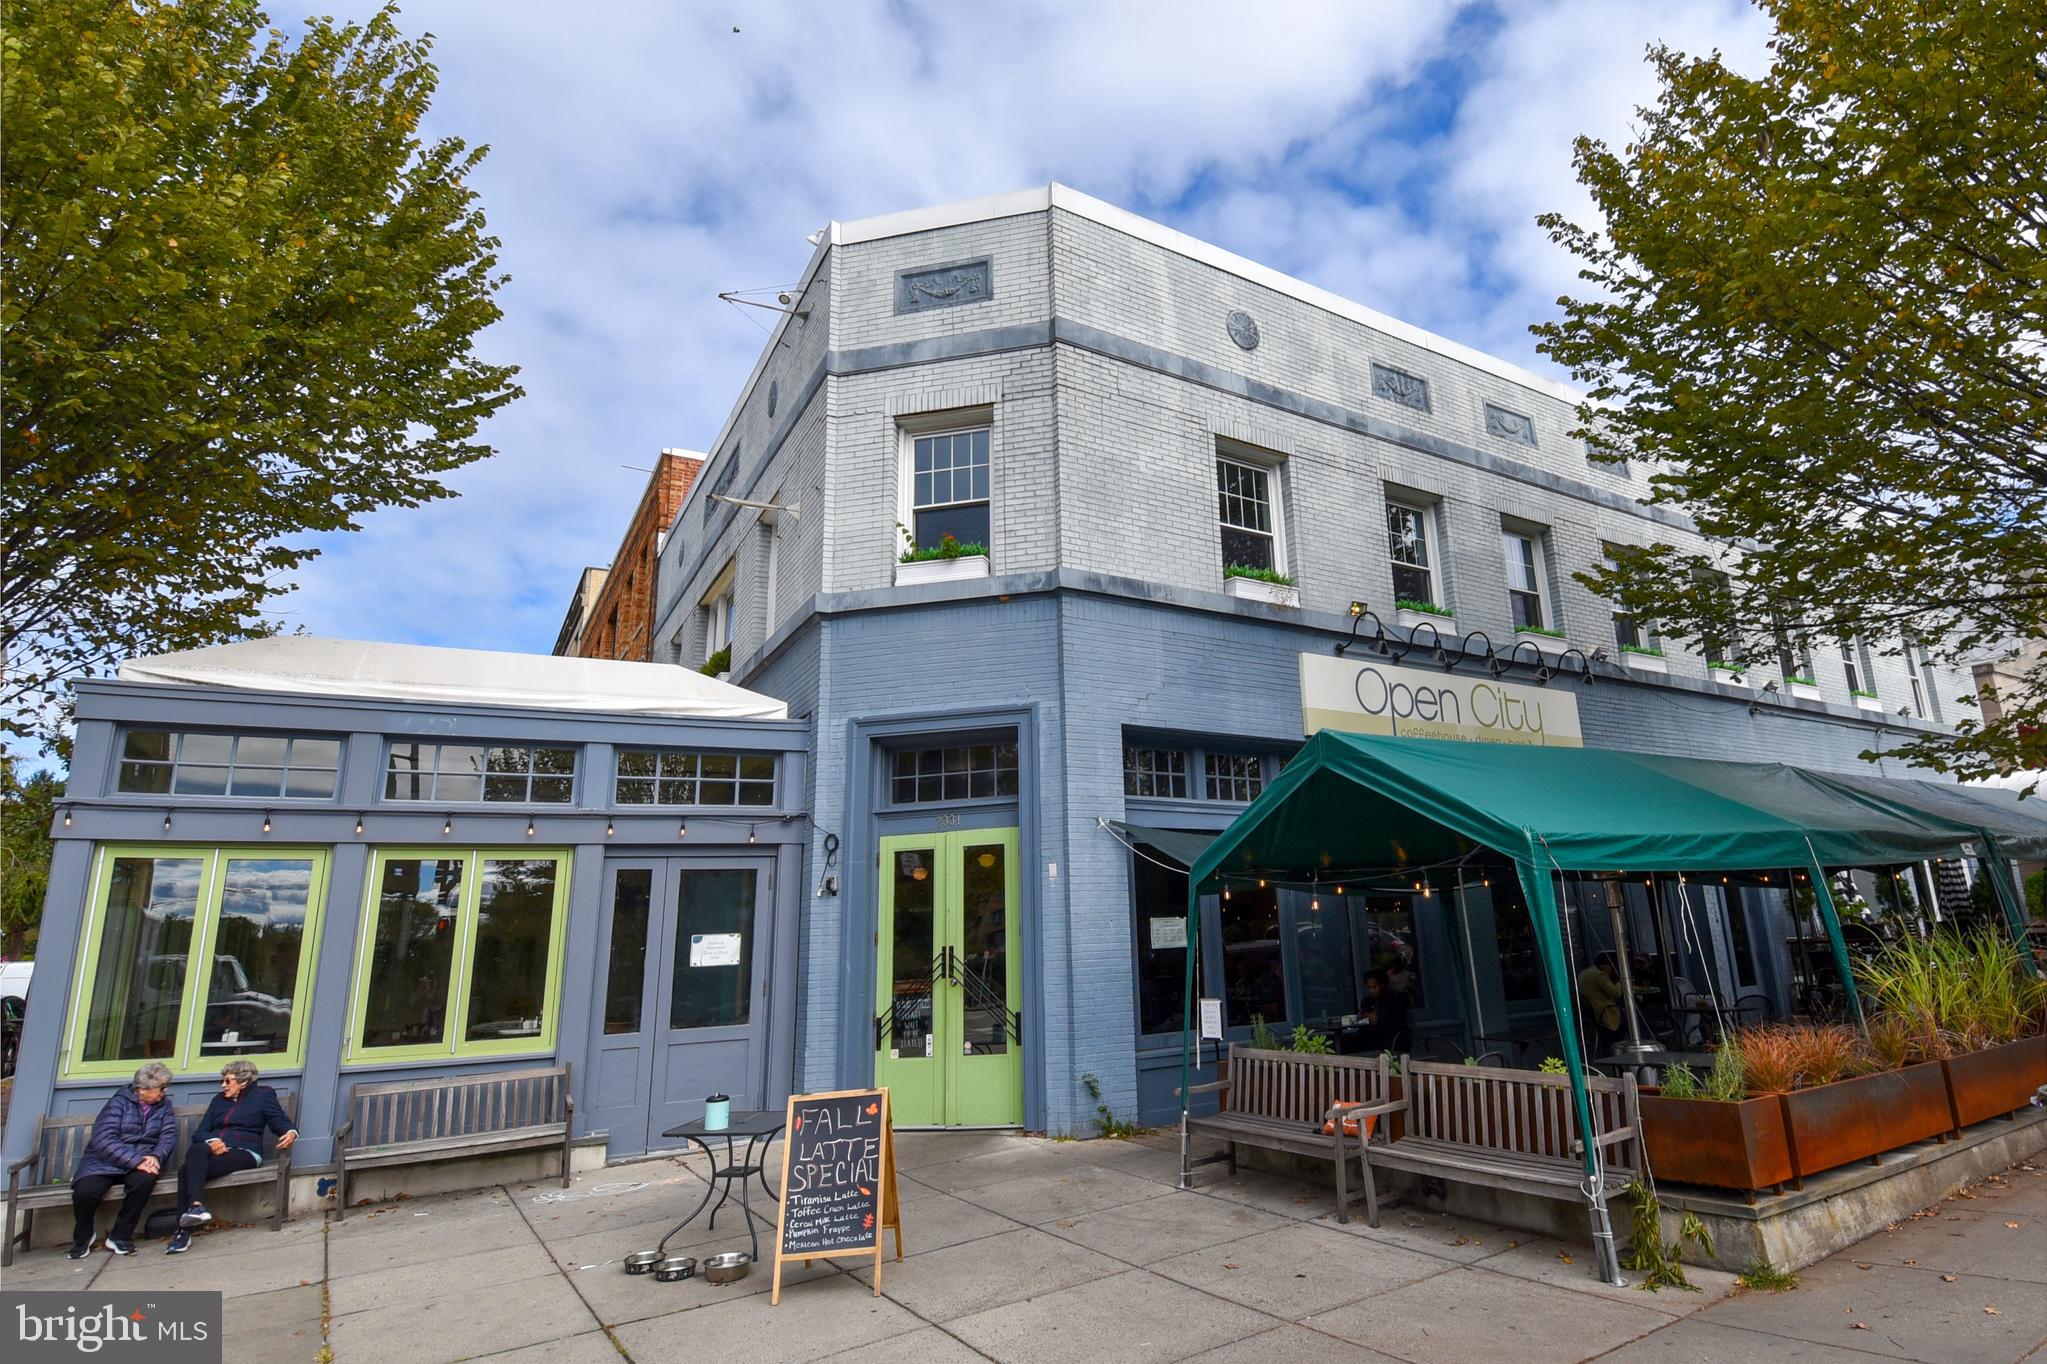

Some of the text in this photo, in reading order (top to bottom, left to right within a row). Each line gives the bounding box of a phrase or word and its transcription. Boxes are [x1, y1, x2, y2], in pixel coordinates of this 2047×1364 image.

[1355, 667, 1545, 746] Open City
[936, 814, 960, 826] 2331
[800, 1105, 872, 1136] FALL
[799, 1137, 880, 1161] LATTE
[788, 1158, 879, 1192] SPECIAL
[789, 1190, 859, 1205] Tiramisu Latte
[791, 1206, 821, 1218] Toffee
[847, 1201, 871, 1210] Latte
[834, 1213, 859, 1222] Latte
[788, 1224, 851, 1239] Pumpkin Frappe
[788, 1240, 820, 1250] Mexican
[822, 1238, 835, 1246] Hot
